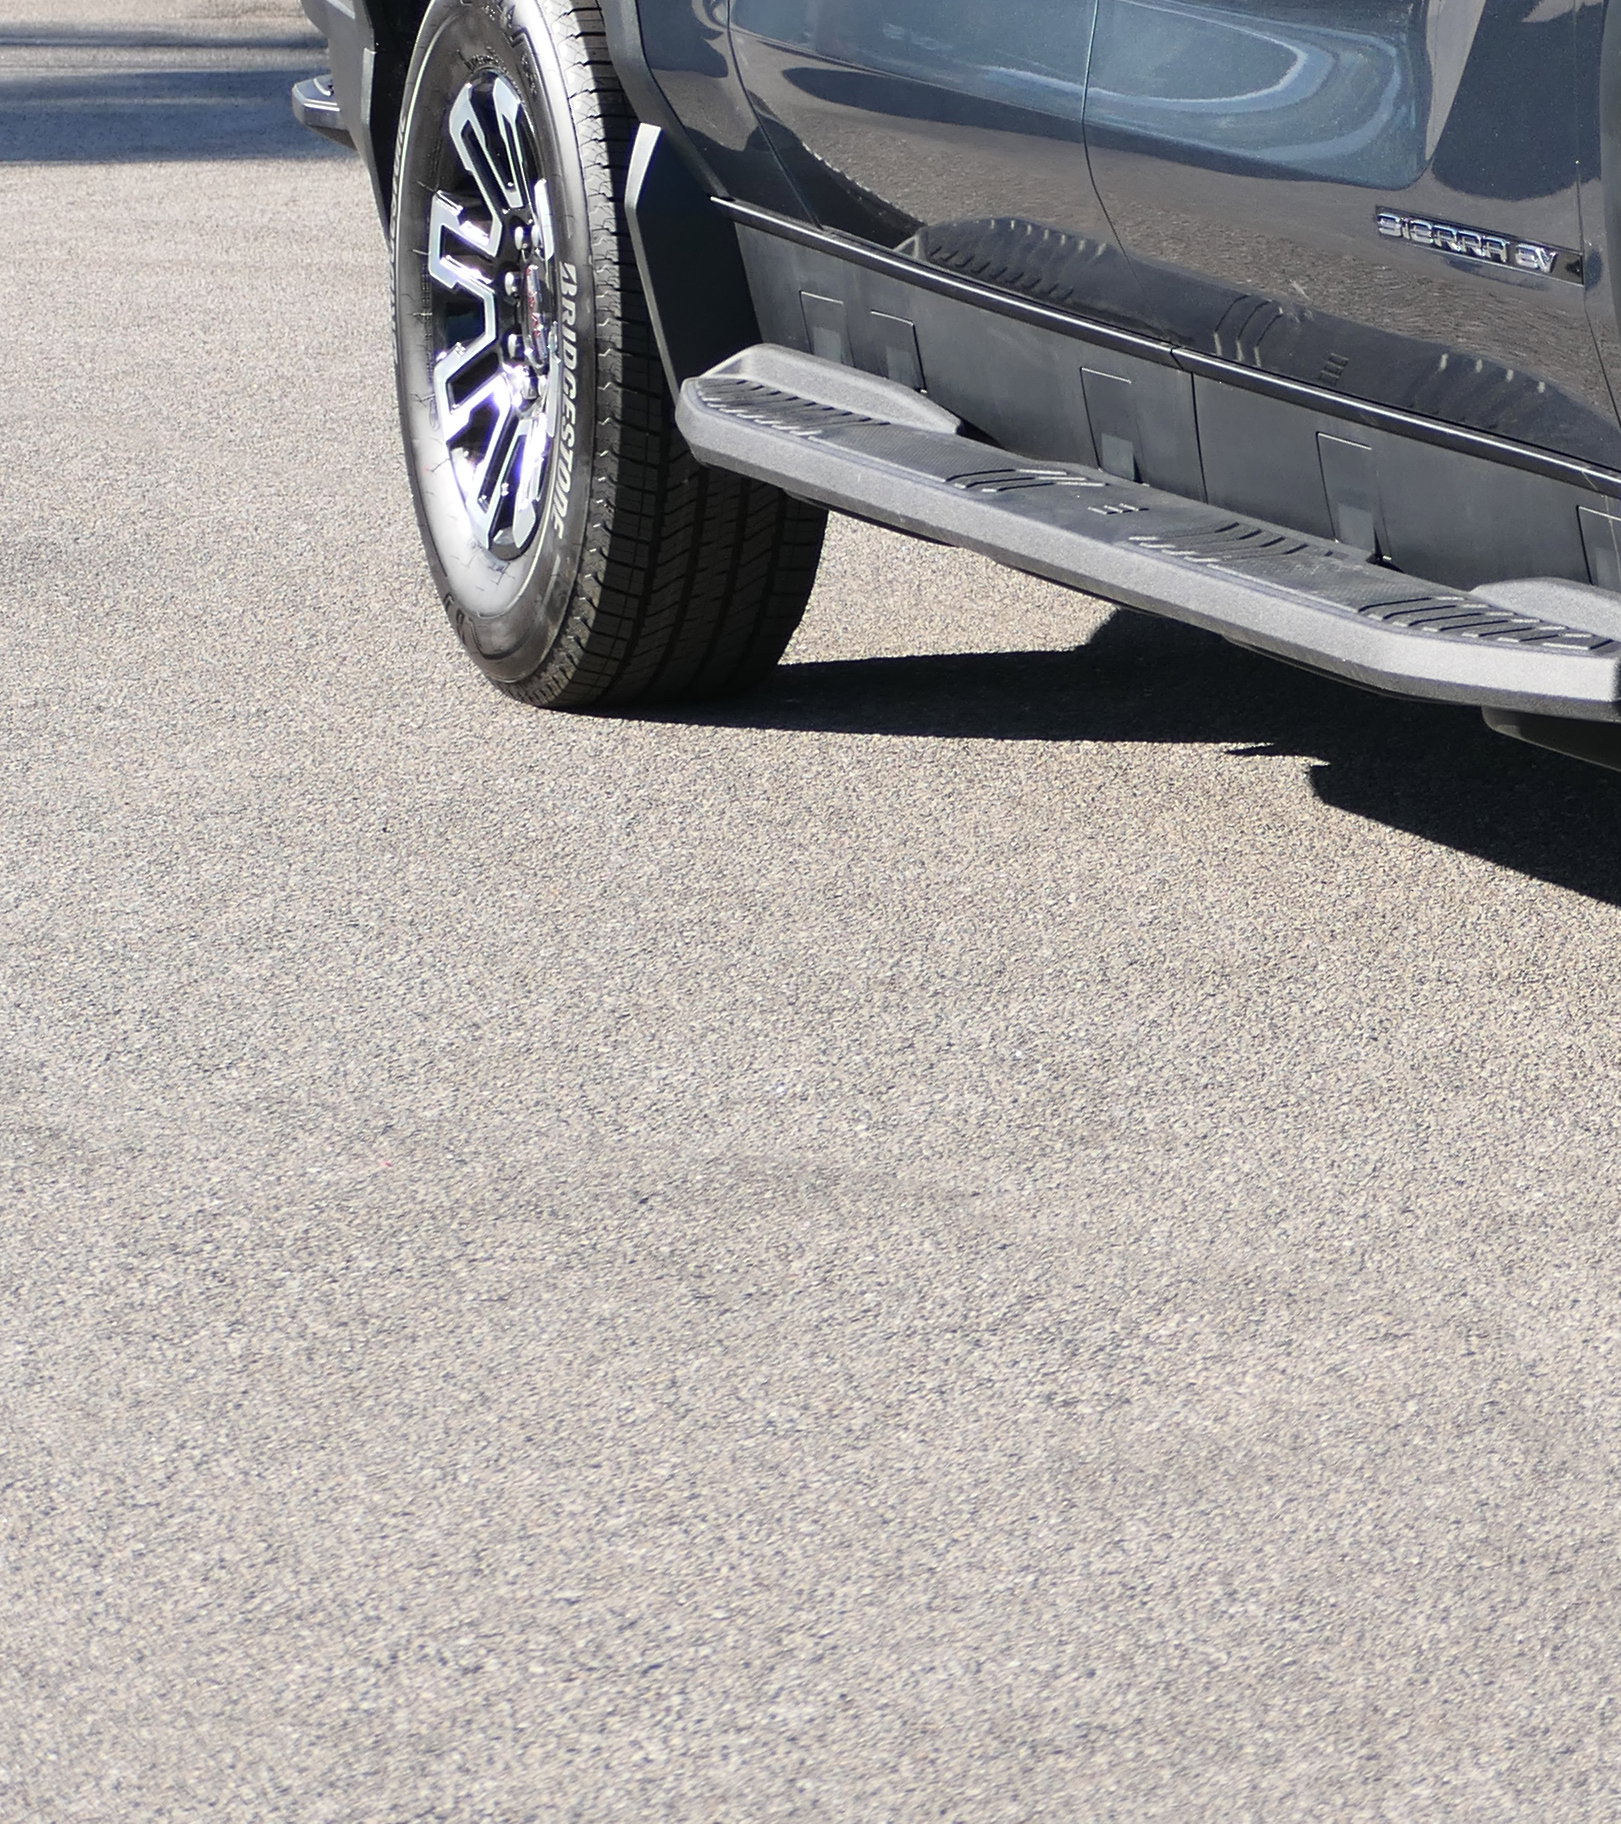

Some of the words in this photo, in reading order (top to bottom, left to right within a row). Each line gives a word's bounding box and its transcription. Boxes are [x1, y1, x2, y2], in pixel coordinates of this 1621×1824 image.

[1376, 211, 1511, 263] SIERRA
[1516, 242, 1558, 274] EV
[554, 261, 578, 540] BRIDGESTONE
